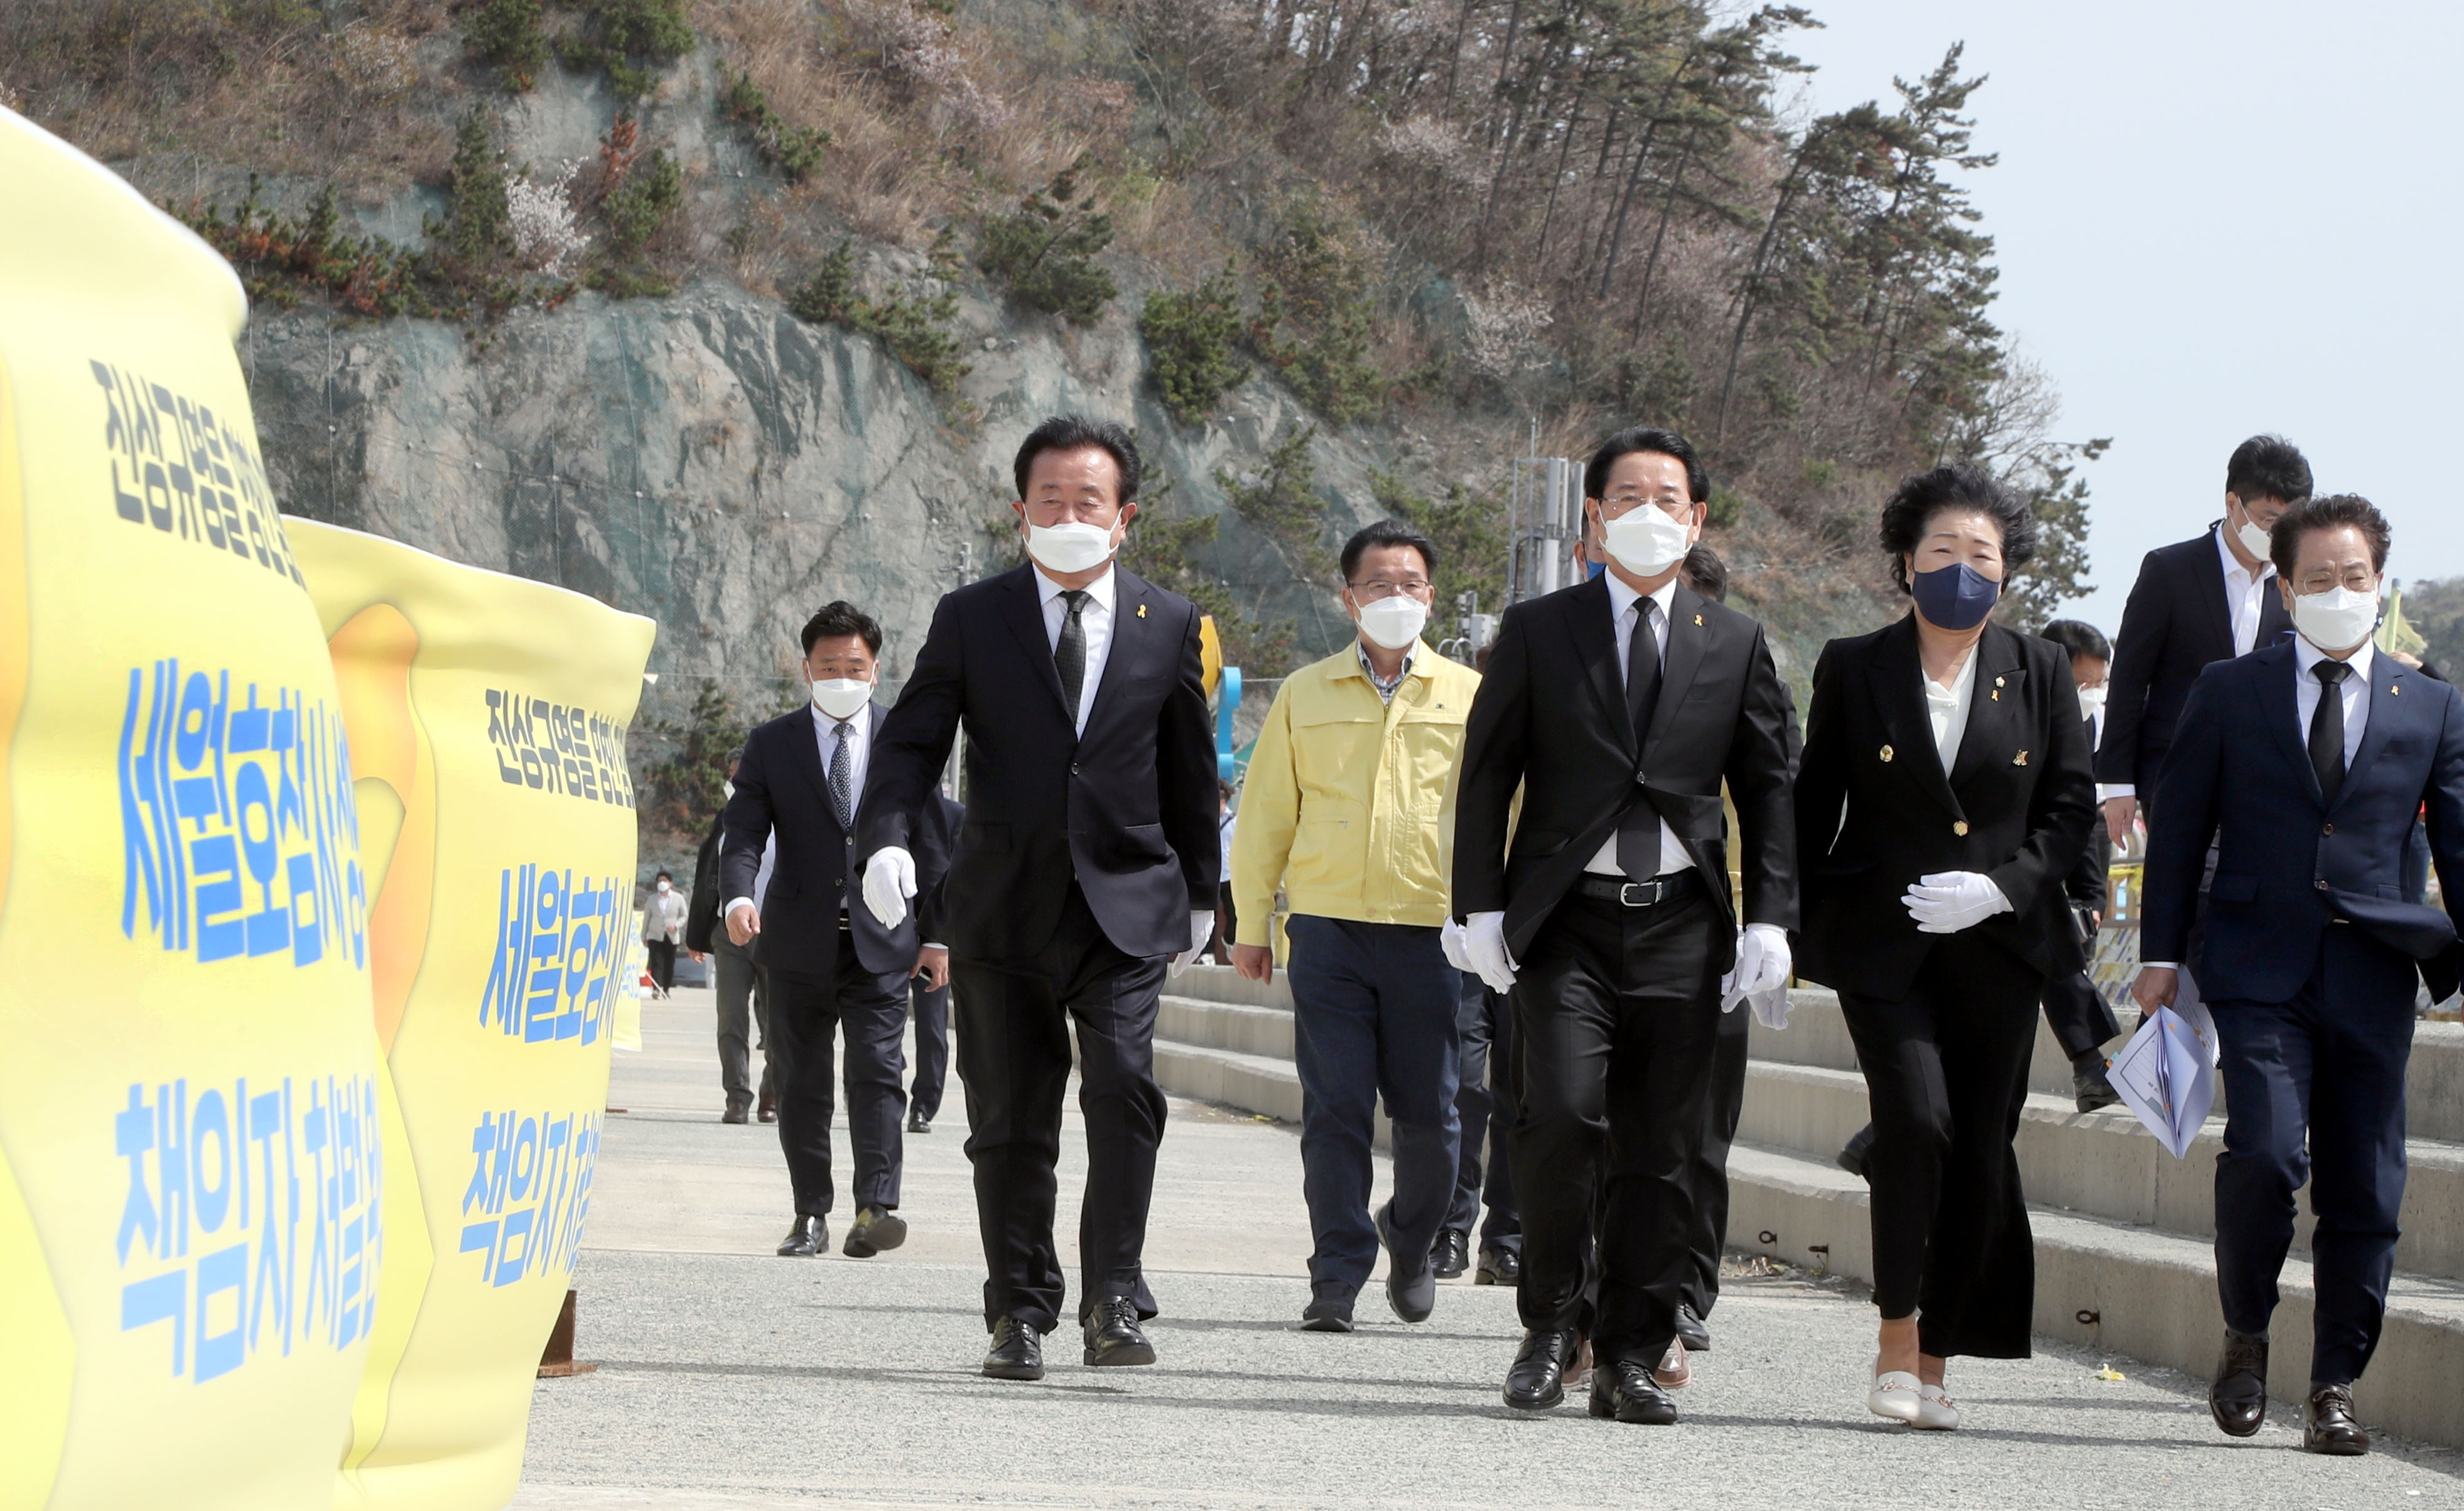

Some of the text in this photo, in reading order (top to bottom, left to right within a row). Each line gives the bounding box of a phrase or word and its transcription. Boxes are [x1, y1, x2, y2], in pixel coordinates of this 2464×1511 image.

[89, 359, 251, 559] 진상규명을
[485, 688, 598, 801] 진상규명을
[115, 1077, 300, 1385] 책임자
[303, 1073, 365, 1352] 처벌
[459, 1110, 574, 1287] 책임자
